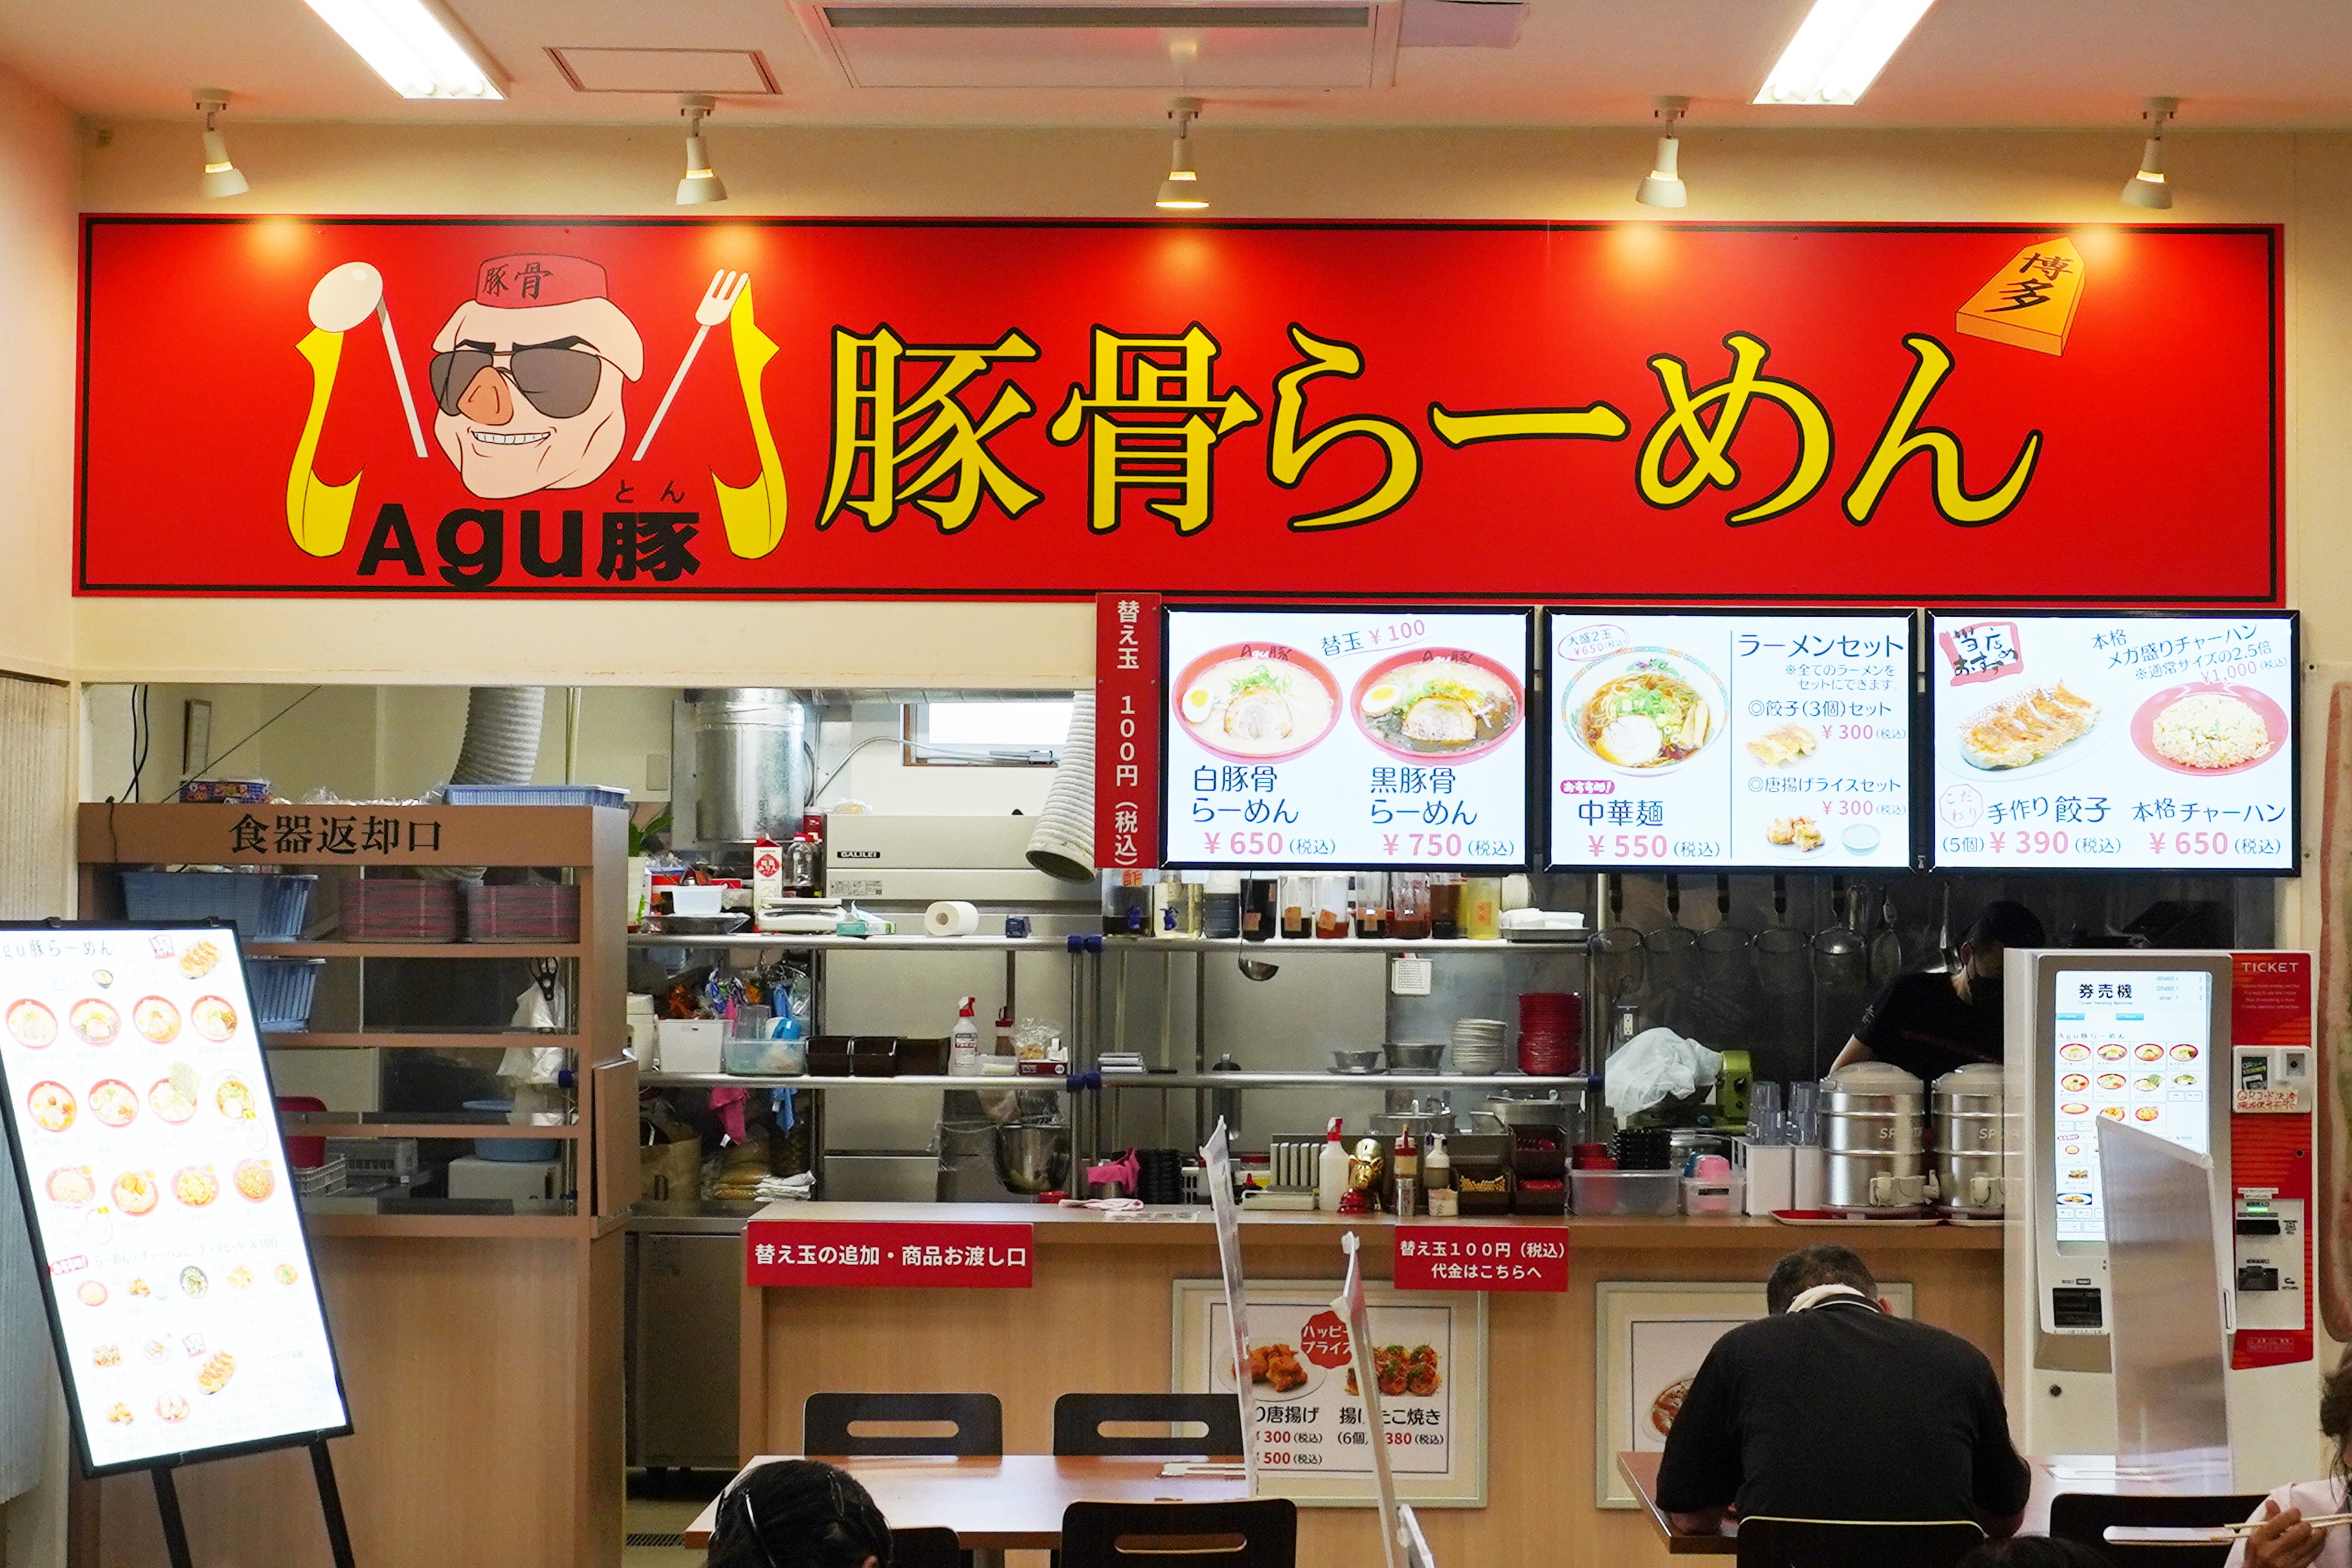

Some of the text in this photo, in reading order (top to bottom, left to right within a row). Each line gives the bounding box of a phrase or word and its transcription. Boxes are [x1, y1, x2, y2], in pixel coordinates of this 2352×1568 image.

[482, 262, 553, 299] 豚骨
[1983, 252, 2075, 313] 博多
[816, 321, 2042, 536] 豚骨らーめん
[615, 479, 686, 504] とん
[357, 503, 701, 586] Agu豚
[1117, 600, 1139, 669] 替え玉
[1321, 631, 1364, 656] 替玉
[1567, 629, 1611, 647] 大盛2玉
[1738, 635, 1904, 657] ラーメンセット
[2091, 629, 2127, 650] 本格
[2108, 624, 2257, 669] メガ盛りチャーハン
[1799, 679, 1898, 691] セットにできます。
[1194, 765, 1277, 792] 白豚骨
[1370, 767, 1456, 794] 黒豚骨
[1193, 798, 1299, 823] らーめん
[1371, 800, 1478, 825] らーめん
[1578, 800, 1663, 827] 中華麺
[2131, 797, 2286, 823] 本格チャーハン
[229, 813, 442, 855] 食器返却口
[1204, 831, 1336, 855] ¥650 (税込)
[1383, 834, 1515, 857] ¥750 (税込)
[1588, 834, 1720, 858] ¥550 (税込)
[1989, 831, 2069, 854] ¥390
[2075, 837, 2122, 853] (税込)
[2149, 831, 2281, 855] ¥650 (税込)
[2241, 962, 2299, 973] TICKET
[2078, 984, 2133, 999] 券売機
[755, 1244, 1026, 1267] 替え玉の追加・商品お渡し口
[1431, 1263, 1542, 1279] 代金はこちらへ
